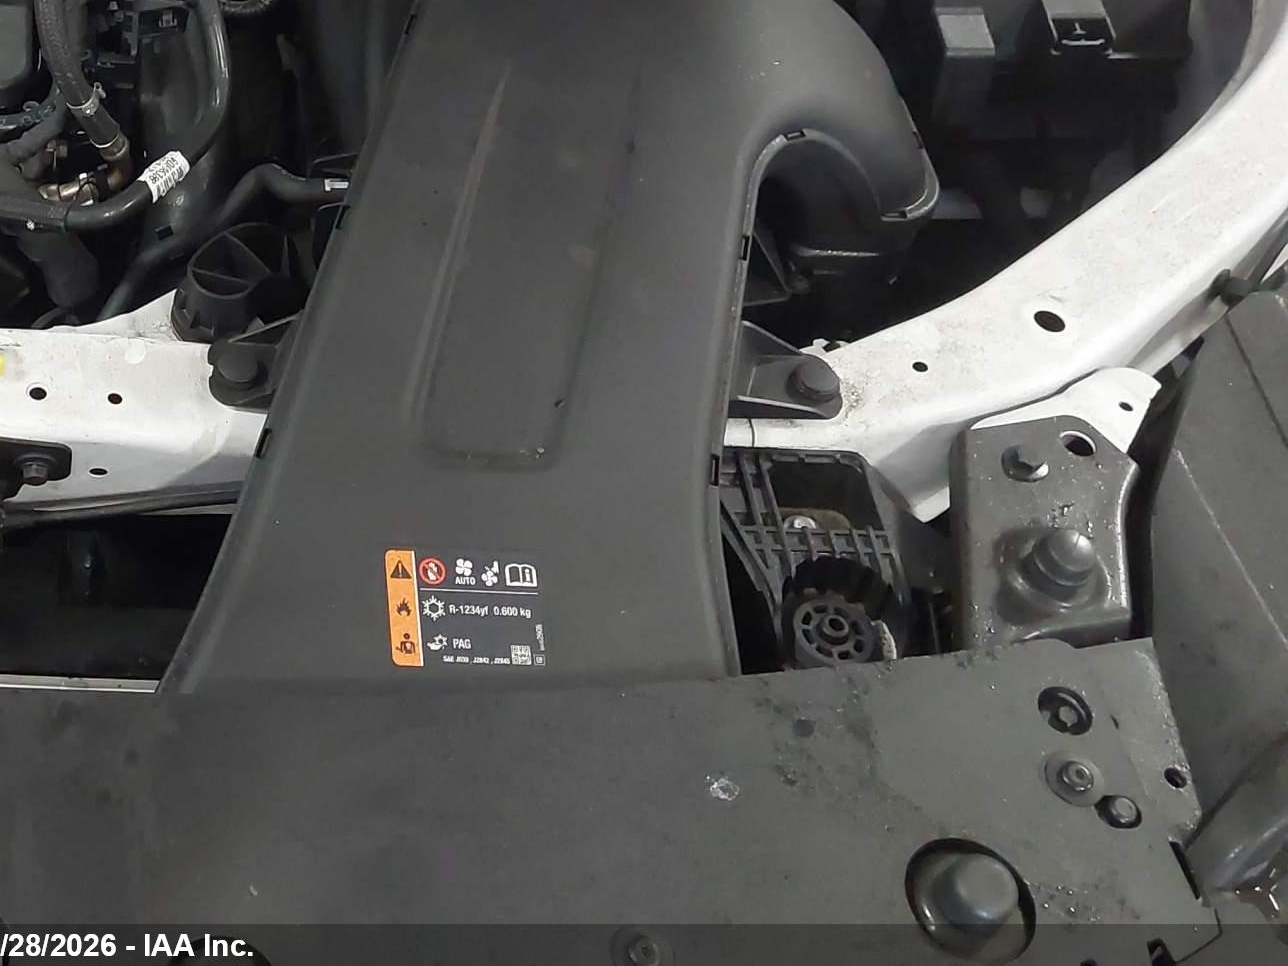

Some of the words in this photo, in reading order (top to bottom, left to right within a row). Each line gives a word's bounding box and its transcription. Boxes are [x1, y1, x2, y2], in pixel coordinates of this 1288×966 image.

[455, 576, 477, 586] AUTO
[449, 603, 490, 618] R-1234yf
[493, 607, 518, 617] 0.600
[520, 607, 532, 620] kg
[452, 638, 472, 650] PAG
